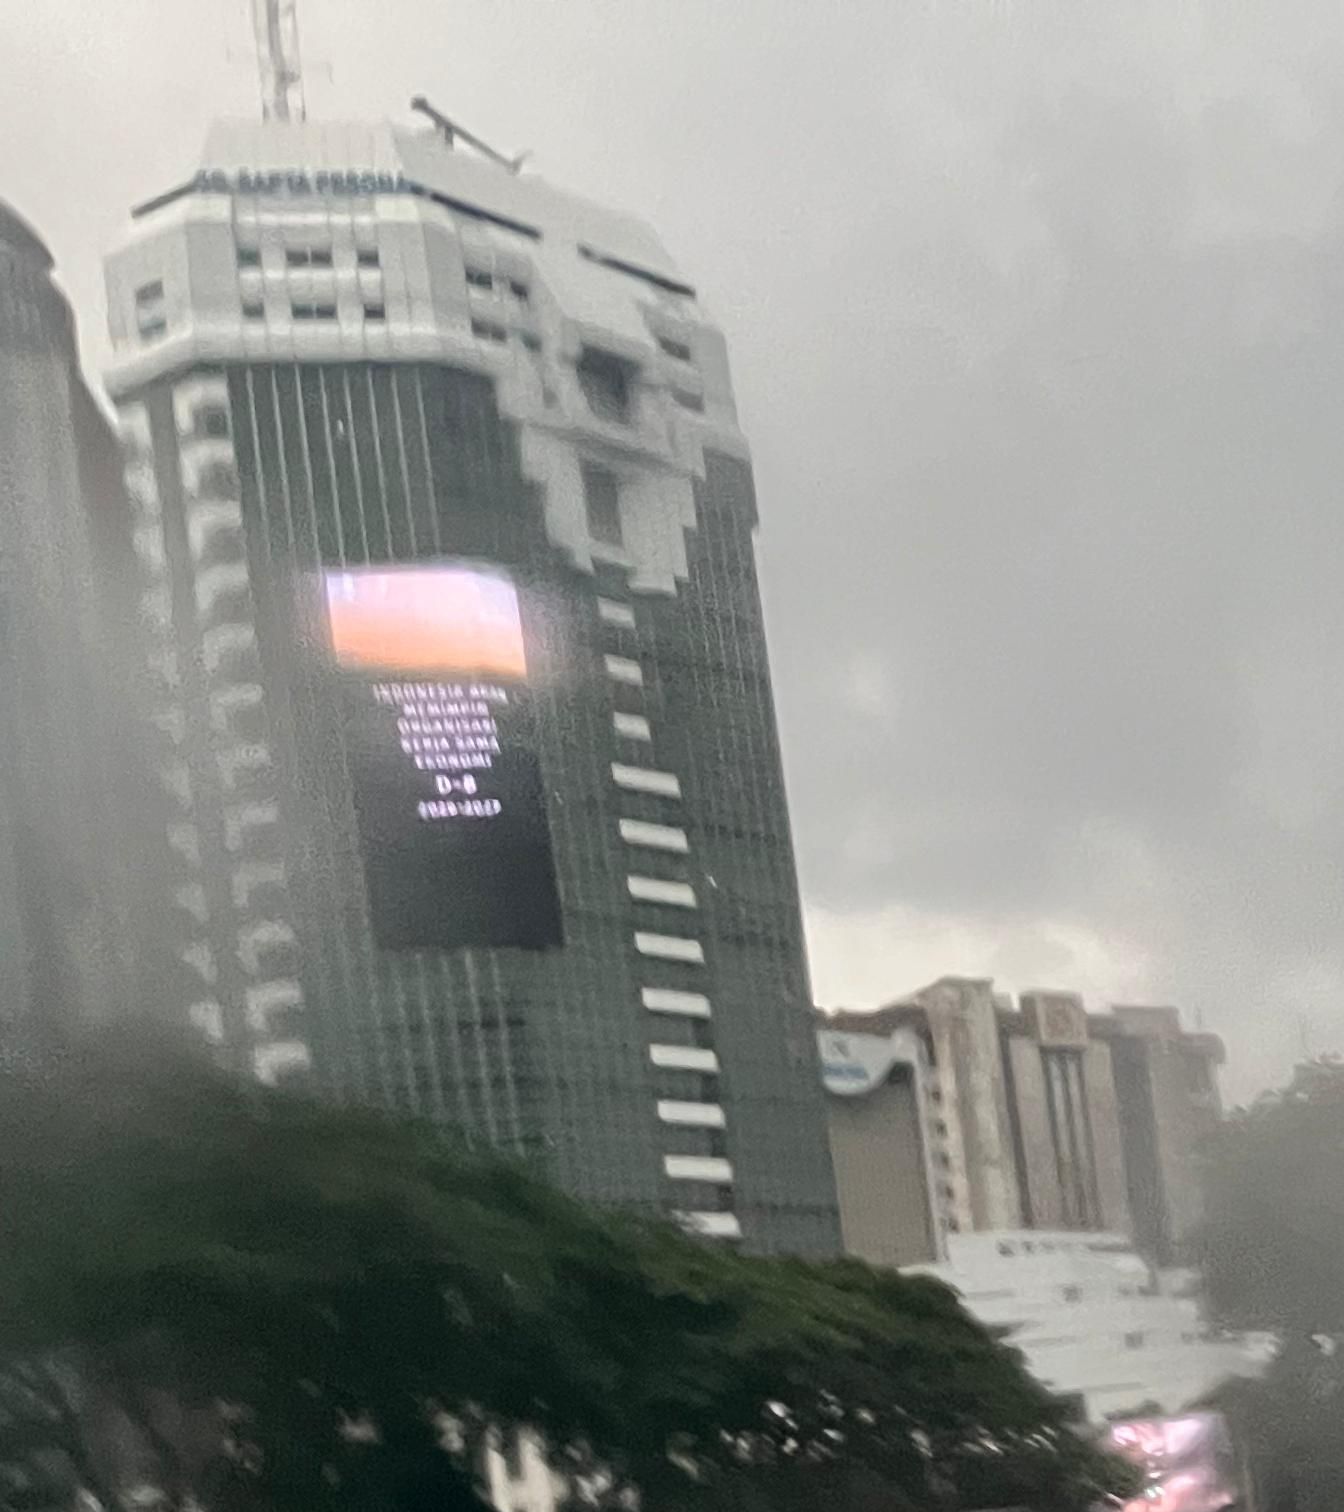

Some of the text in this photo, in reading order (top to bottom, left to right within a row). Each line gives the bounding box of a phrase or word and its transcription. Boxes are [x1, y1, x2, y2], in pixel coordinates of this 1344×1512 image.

[372, 683, 464, 704] INDONESIA
[403, 702, 489, 717] MEMIMPIN
[414, 753, 492, 769] EKONOMI
